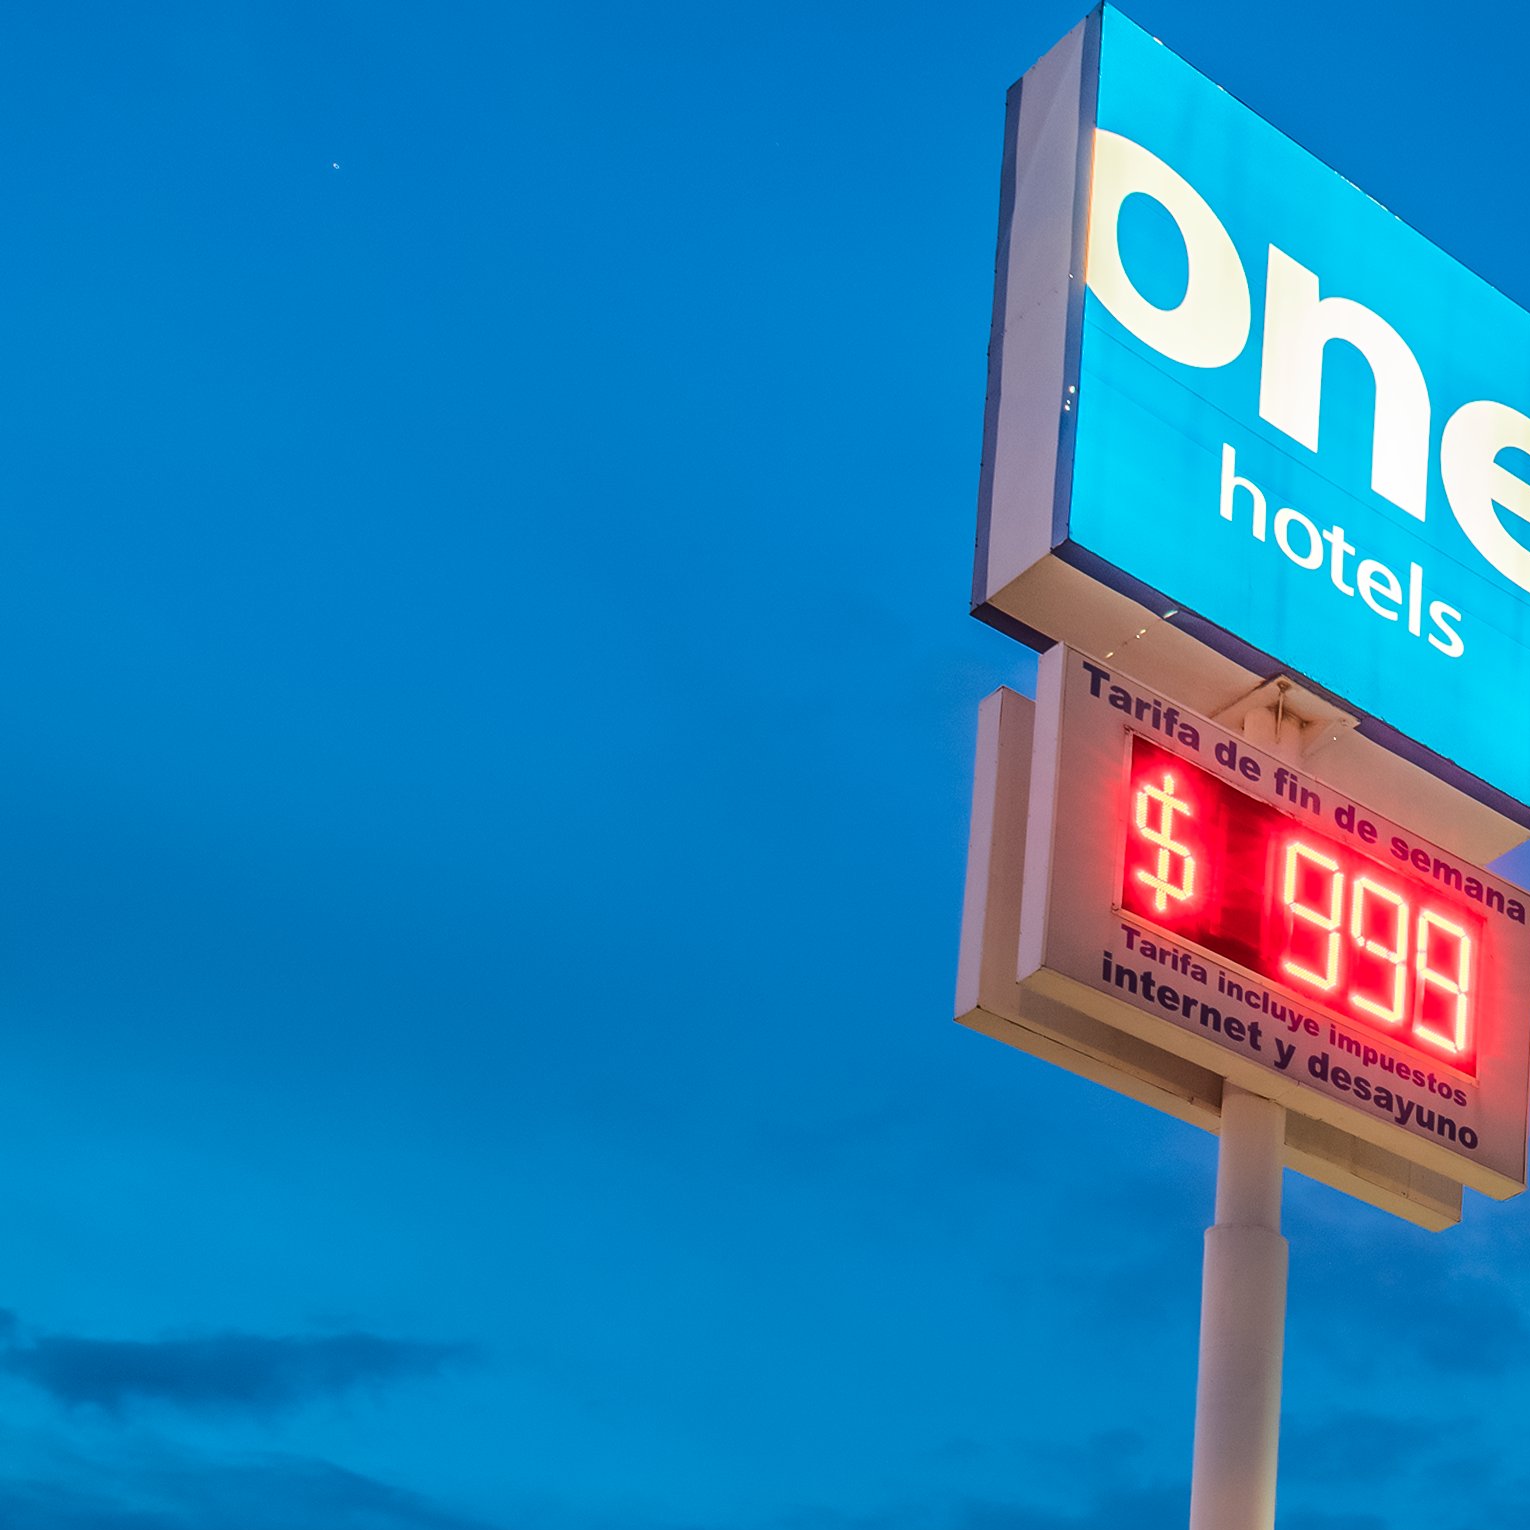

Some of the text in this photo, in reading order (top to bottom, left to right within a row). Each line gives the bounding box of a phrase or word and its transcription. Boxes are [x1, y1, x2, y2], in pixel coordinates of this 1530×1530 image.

[1219, 442, 1465, 659] hotels
[1081, 661, 1527, 925] Tarifa de fin de semana
[1120, 924, 1469, 1107] Tarifa incluye impuestos
[1135, 774, 1471, 1054] $ 999
[1102, 950, 1479, 1150] internet y desayuno
